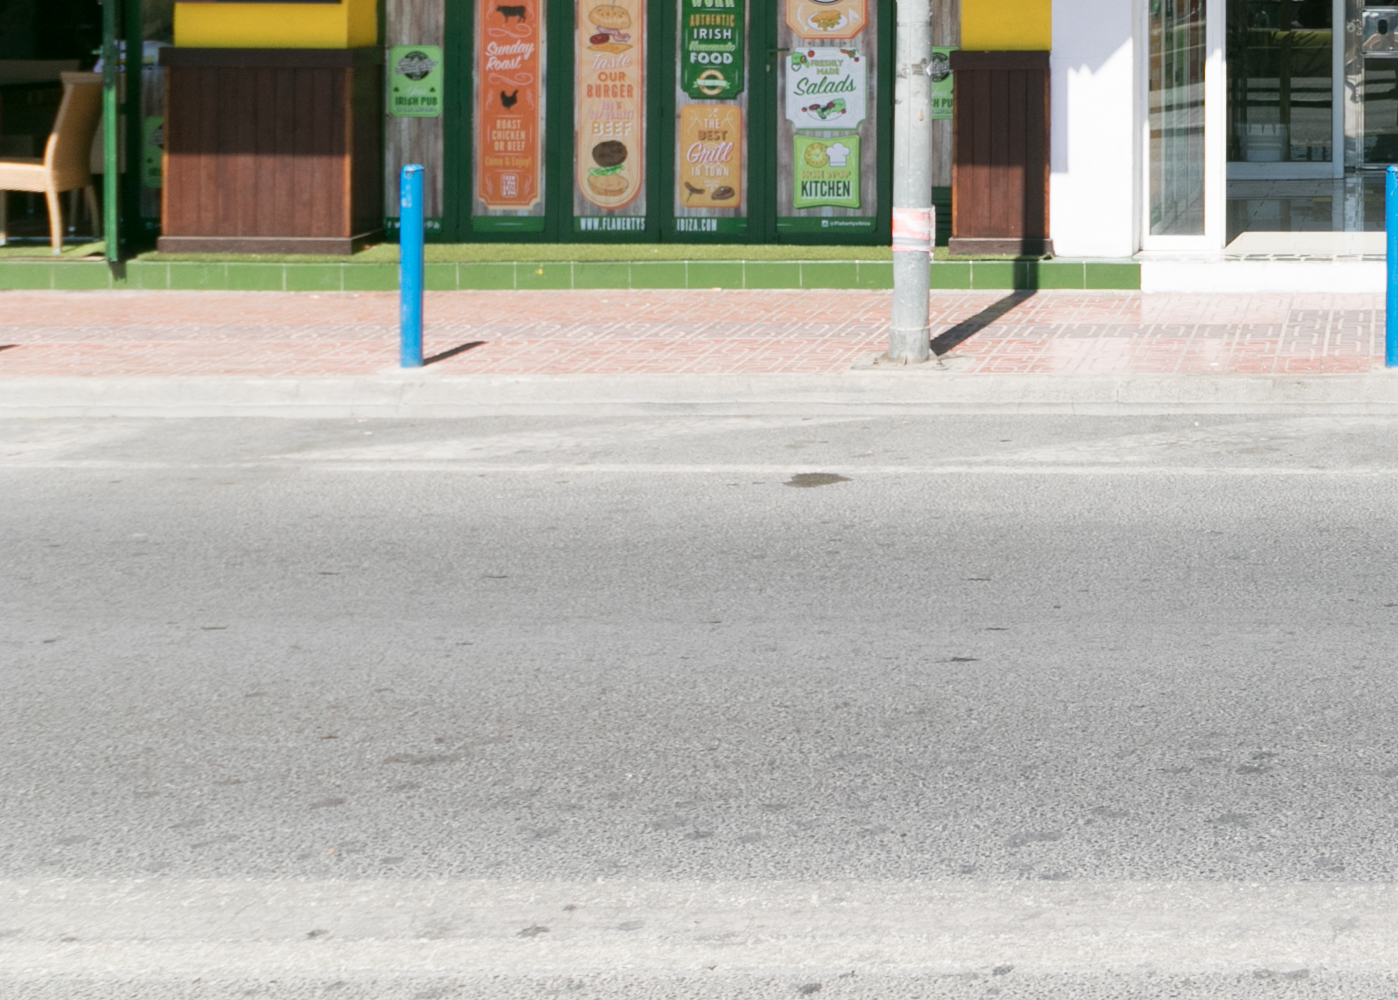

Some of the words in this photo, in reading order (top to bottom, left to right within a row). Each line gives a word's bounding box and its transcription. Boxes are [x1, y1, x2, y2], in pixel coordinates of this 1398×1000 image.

[689, 14, 735, 27] AUTHENTIC
[693, 28, 732, 40] IRISH
[485, 39, 535, 60] Sunday
[689, 41, 736, 52] Homemade
[486, 56, 522, 71] Roast
[592, 53, 632, 70] Taste
[690, 52, 733, 64] FOOD
[810, 59, 843, 67] FRESHLY
[598, 71, 627, 82] OUR
[816, 68, 840, 76] MADE
[793, 74, 856, 96] Salads
[587, 84, 634, 99] BURGER
[395, 96, 419, 106] IRISH
[420, 96, 438, 106] PUB
[496, 119, 522, 130] ROAST
[591, 121, 633, 137] BEEF
[704, 118, 720, 129] THE
[491, 130, 526, 140] CHICKEN
[698, 130, 728, 141] BEST
[494, 141, 505, 151] OR
[507, 141, 526, 152] BEEF
[686, 141, 734, 164] Grill
[691, 166, 701, 177] IN
[705, 166, 729, 177] TOWN
[801, 180, 852, 199] KITCHEN
[580, 217, 646, 231] WWW.FLAHERTYS
[676, 218, 718, 232] IBIZA.COM
